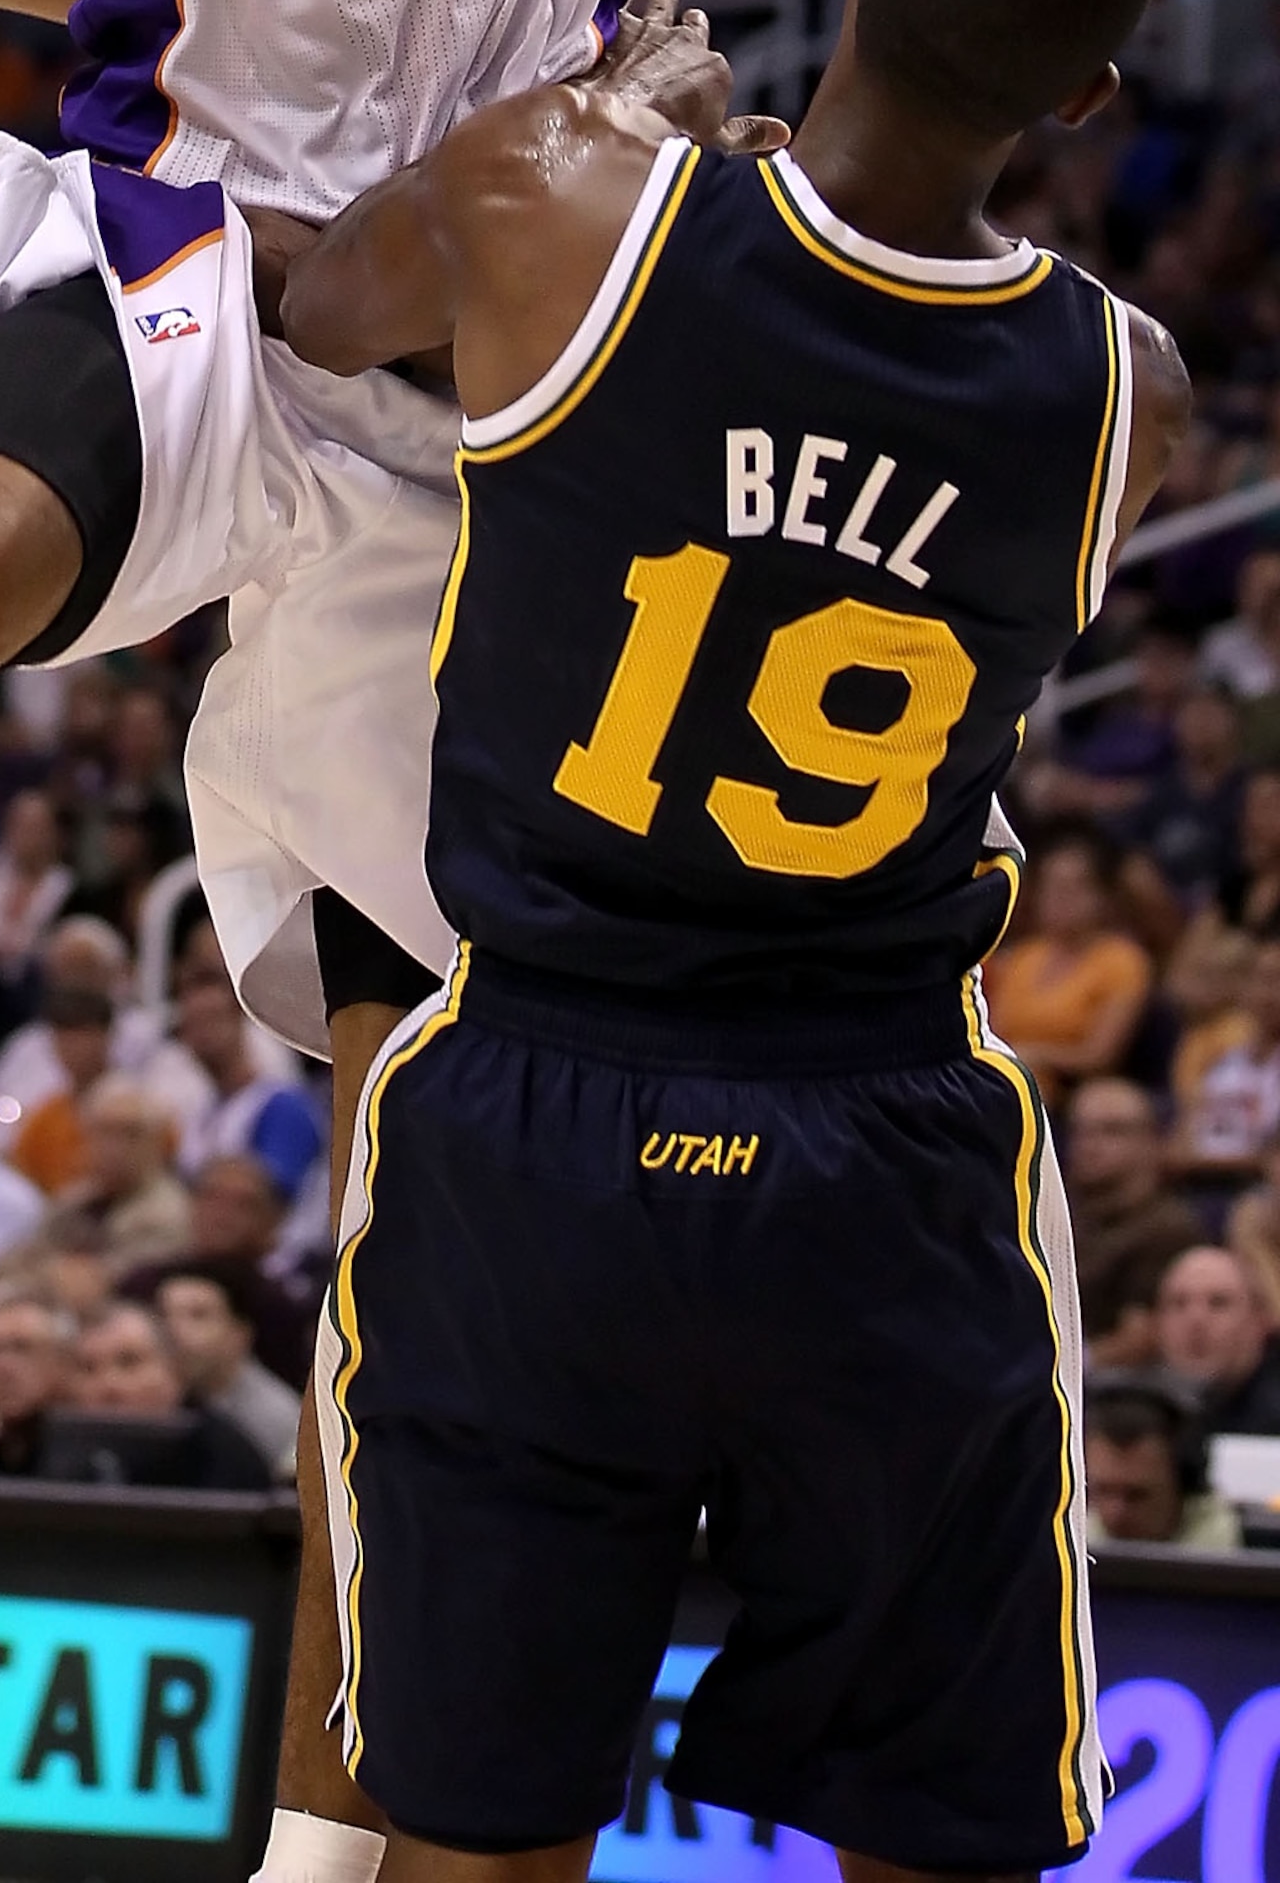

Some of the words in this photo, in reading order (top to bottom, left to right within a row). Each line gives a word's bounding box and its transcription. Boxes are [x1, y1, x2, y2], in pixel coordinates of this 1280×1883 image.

[726, 427, 960, 589] BELL
[552, 540, 978, 880] 19
[639, 1131, 760, 1176] UTAH
